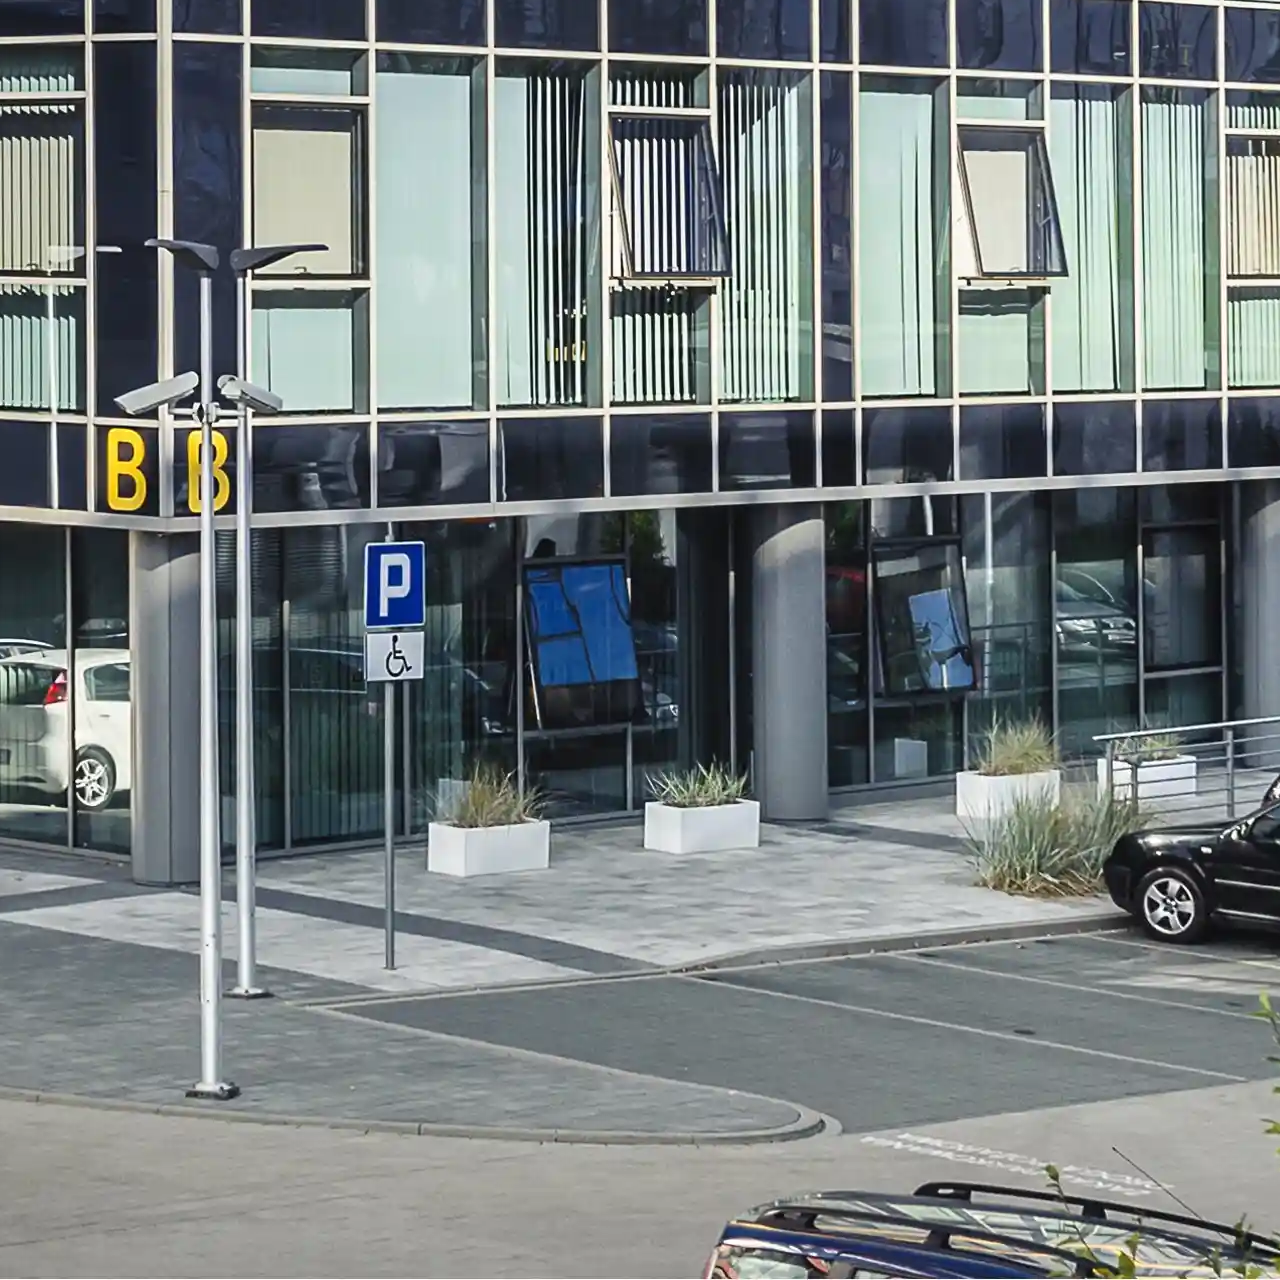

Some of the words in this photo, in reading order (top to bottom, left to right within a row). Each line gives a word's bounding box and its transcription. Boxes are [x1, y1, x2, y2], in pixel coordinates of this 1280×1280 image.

[107, 427, 147, 511] B
[186, 429, 230, 513] B
[379, 552, 411, 618] P
